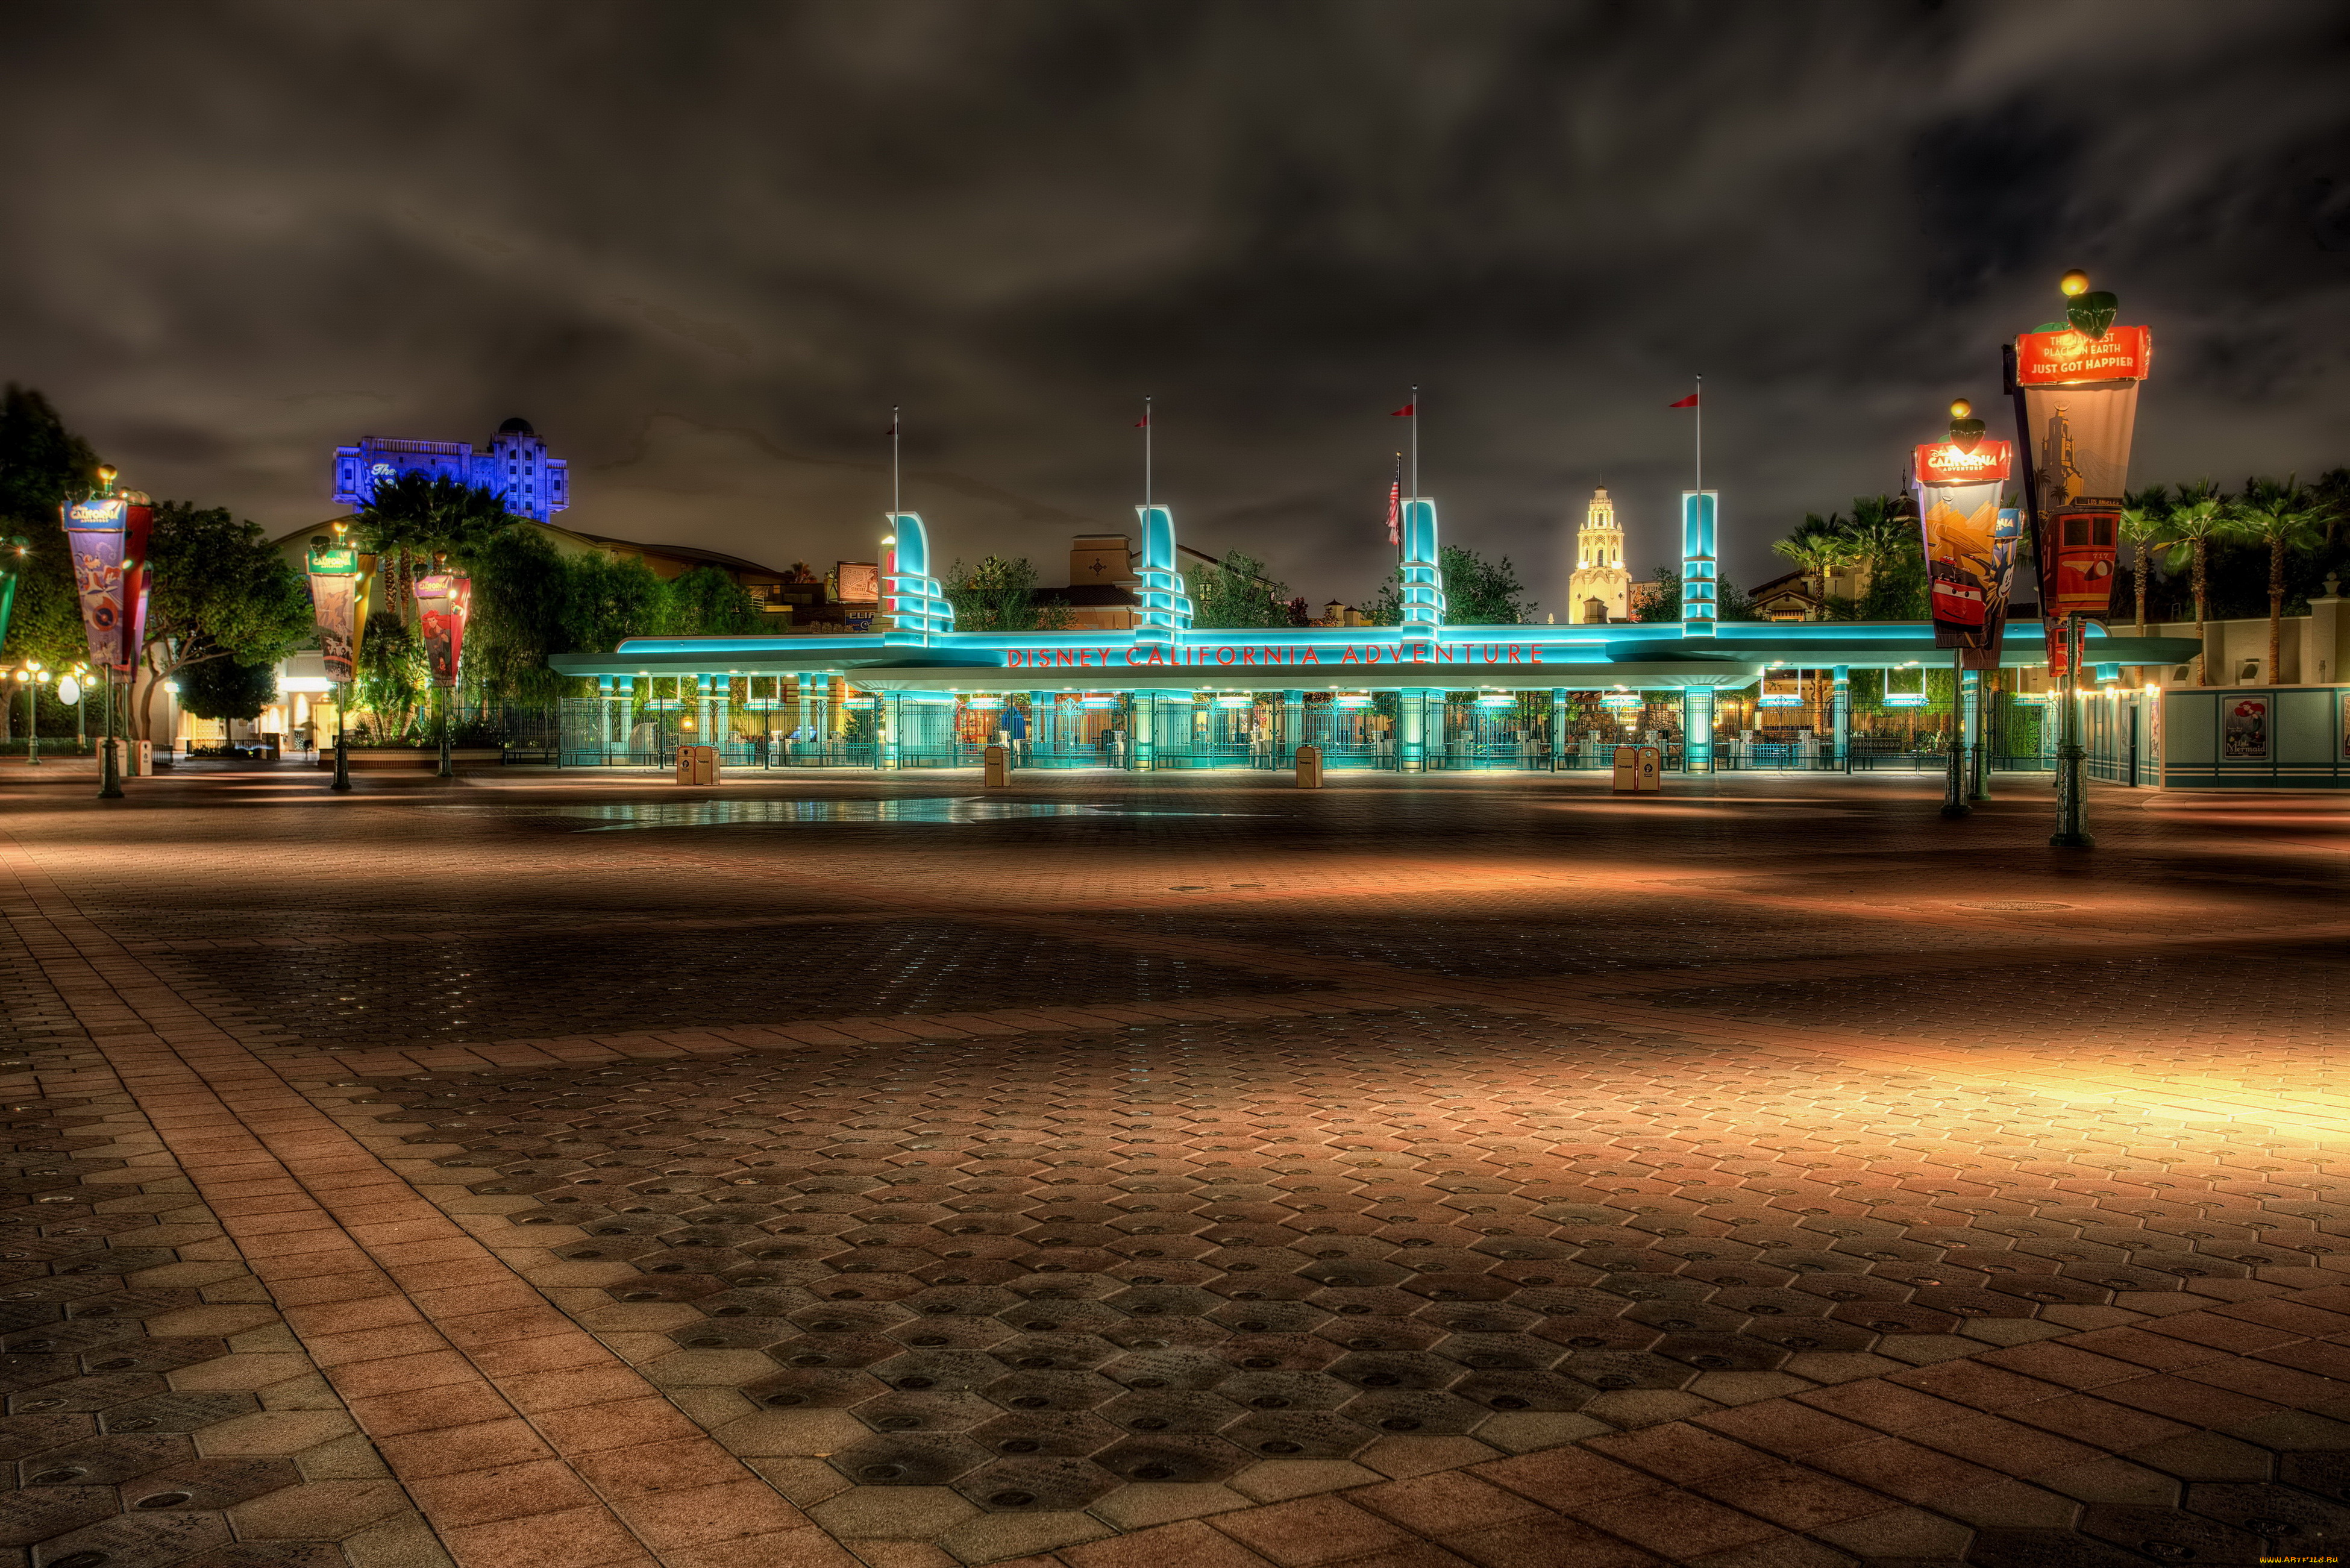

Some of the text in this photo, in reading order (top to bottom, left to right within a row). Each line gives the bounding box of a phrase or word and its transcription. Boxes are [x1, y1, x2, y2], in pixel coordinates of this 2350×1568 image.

[2090, 343, 2120, 354] EARTH
[2031, 357, 2134, 374] JUST GOT HAPPIER
[1928, 455, 1998, 468] CALIFORNIA
[371, 463, 397, 475] The
[70, 509, 119, 520] CALIFORNIA
[1007, 643, 1543, 668] DISNEY CALIFORNIA ADVENTURE
[2226, 741, 2266, 753] Mermaid
